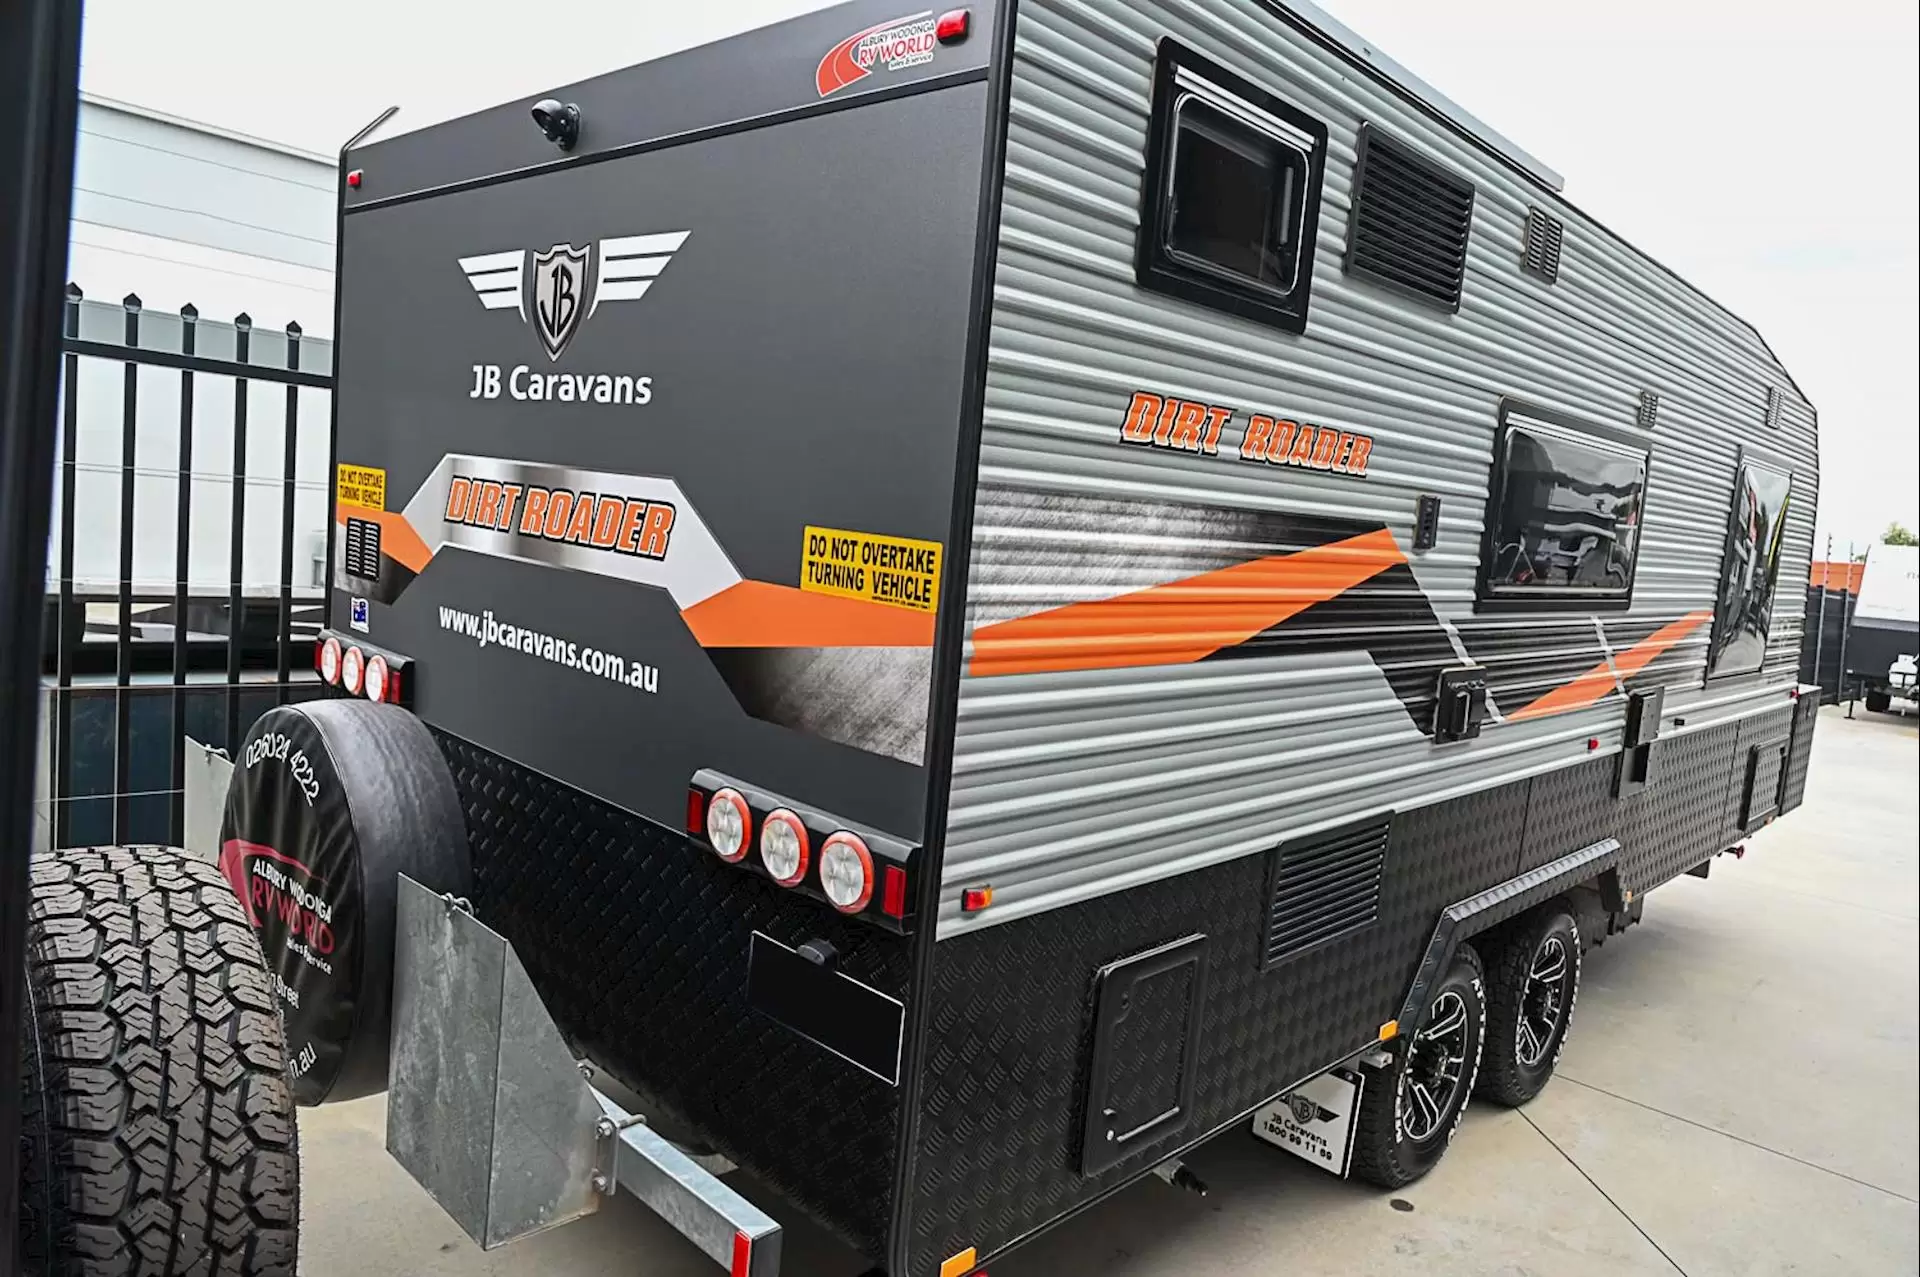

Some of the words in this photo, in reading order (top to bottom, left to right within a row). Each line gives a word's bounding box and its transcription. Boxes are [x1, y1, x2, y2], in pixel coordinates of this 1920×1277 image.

[860, 35, 887, 46] ALBURY
[890, 22, 934, 39] WODONGA
[860, 47, 878, 64] RV
[880, 34, 934, 61] WORLD
[470, 364, 502, 400] JB
[509, 364, 653, 405] Caravans
[1120, 391, 1236, 456] DIRT
[1240, 413, 1375, 479] ROADER
[444, 474, 522, 534] DIRT
[518, 484, 677, 562] ROADER
[809, 534, 827, 558] DO
[831, 537, 858, 562] NOT
[862, 542, 936, 575] OVERTAKE
[808, 561, 864, 592] TURNING
[872, 570, 932, 604] VEHICLE
[438, 605, 660, 694] www.jbcaravans.com.au
[289, 749, 320, 807] 4222
[252, 874, 275, 913] RV
[275, 889, 335, 955] WORLD
[1263, 1121, 1287, 1139] 1800
[1305, 1141, 1317, 1154] 11
[1271, 1112, 1283, 1125] JB
[1284, 1119, 1328, 1147] Caravans
